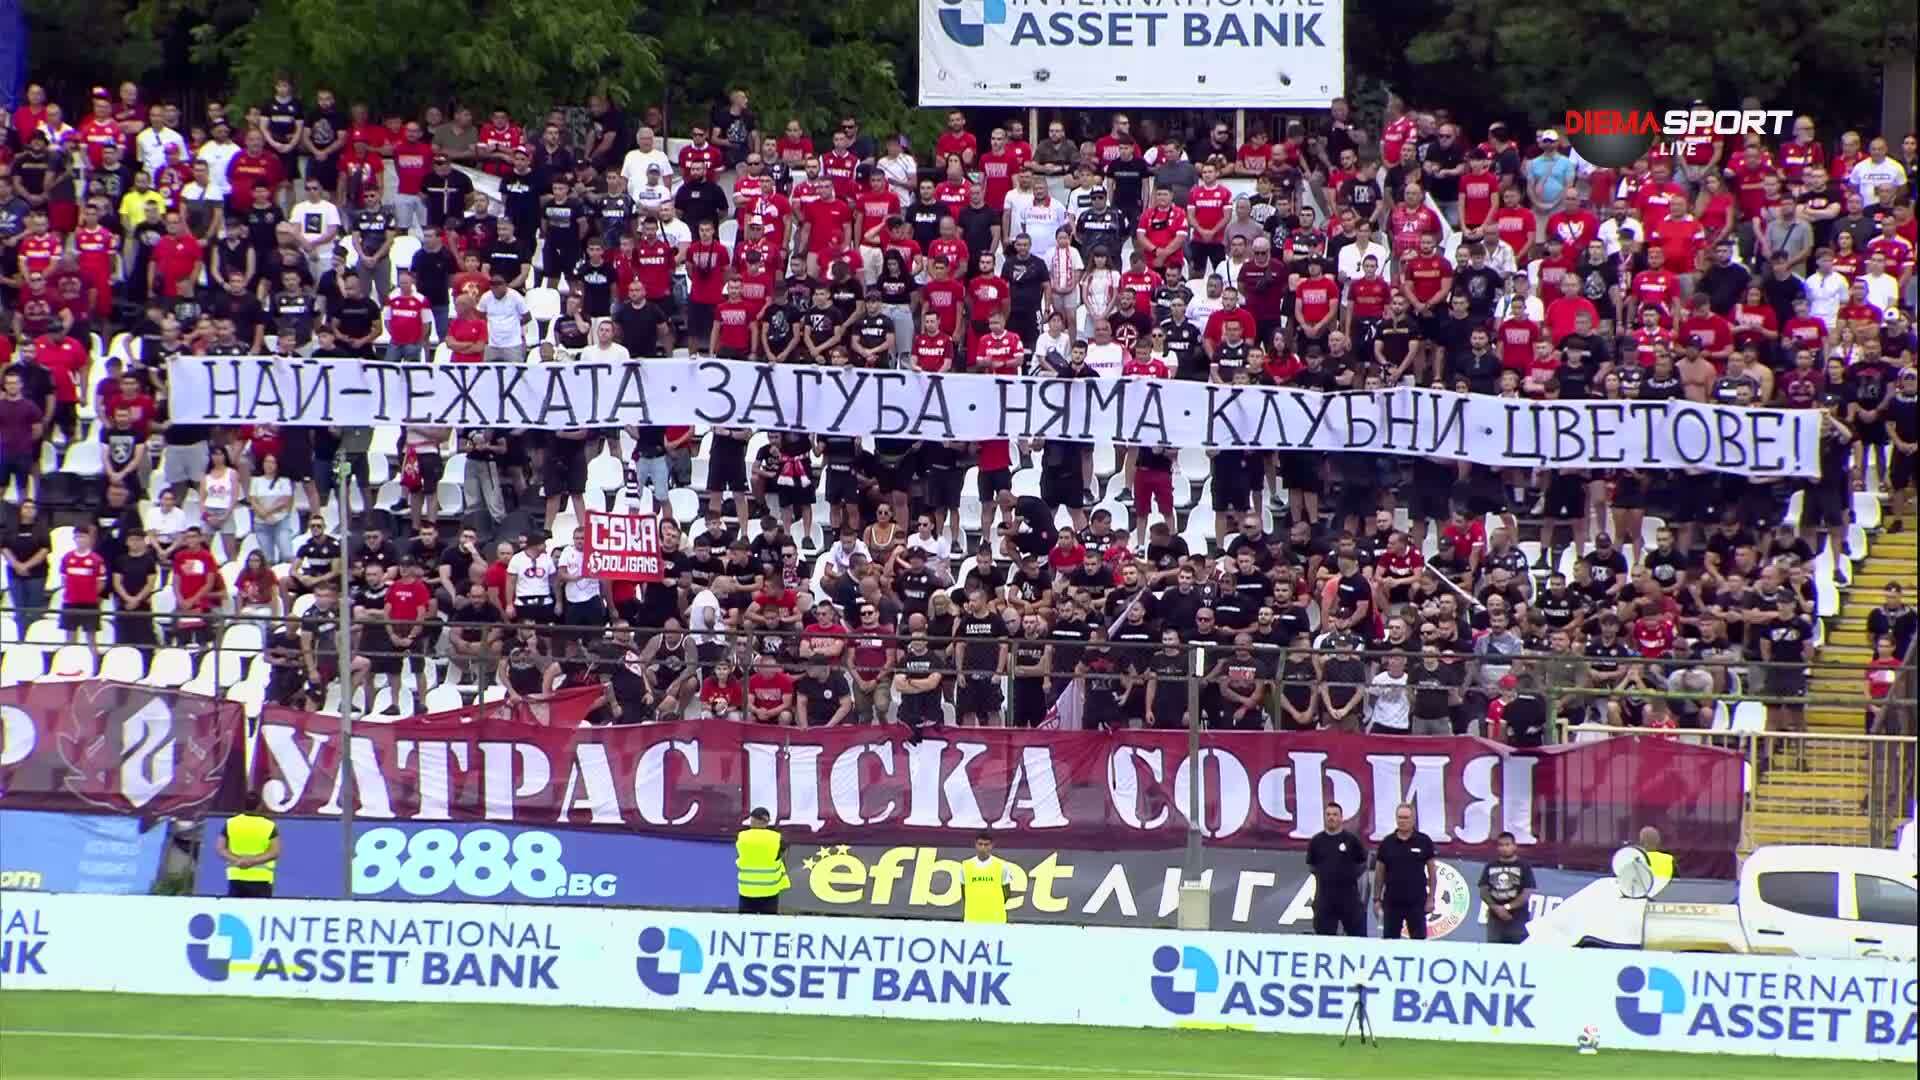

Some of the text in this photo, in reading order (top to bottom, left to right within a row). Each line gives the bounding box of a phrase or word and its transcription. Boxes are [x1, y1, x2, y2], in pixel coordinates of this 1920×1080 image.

[1009, 12, 1326, 47] ASSET BANK
[201, 359, 1801, 471] НАЙ-ТЕЖКАТА ЗАГУБА НЯМА КЛУБНИ ЦВЕТОВЕ!
[590, 514, 657, 553] CSKA
[261, 724, 1539, 846] УЛТРАС ЦСКА СОФИЯ
[809, 847, 1074, 912] efbet
[0, 909, 49, 935] AL
[259, 916, 560, 950] INTERNATIONAL
[708, 930, 1013, 967] INTERNATIONAL
[254, 948, 560, 990] ASSET BANK
[704, 962, 1012, 1007] ASSET BANK
[1225, 949, 1536, 989] INTERNATIONAL
[1393, 988, 1535, 1028] BANK
[1687, 1002, 1851, 1042] ASSET
